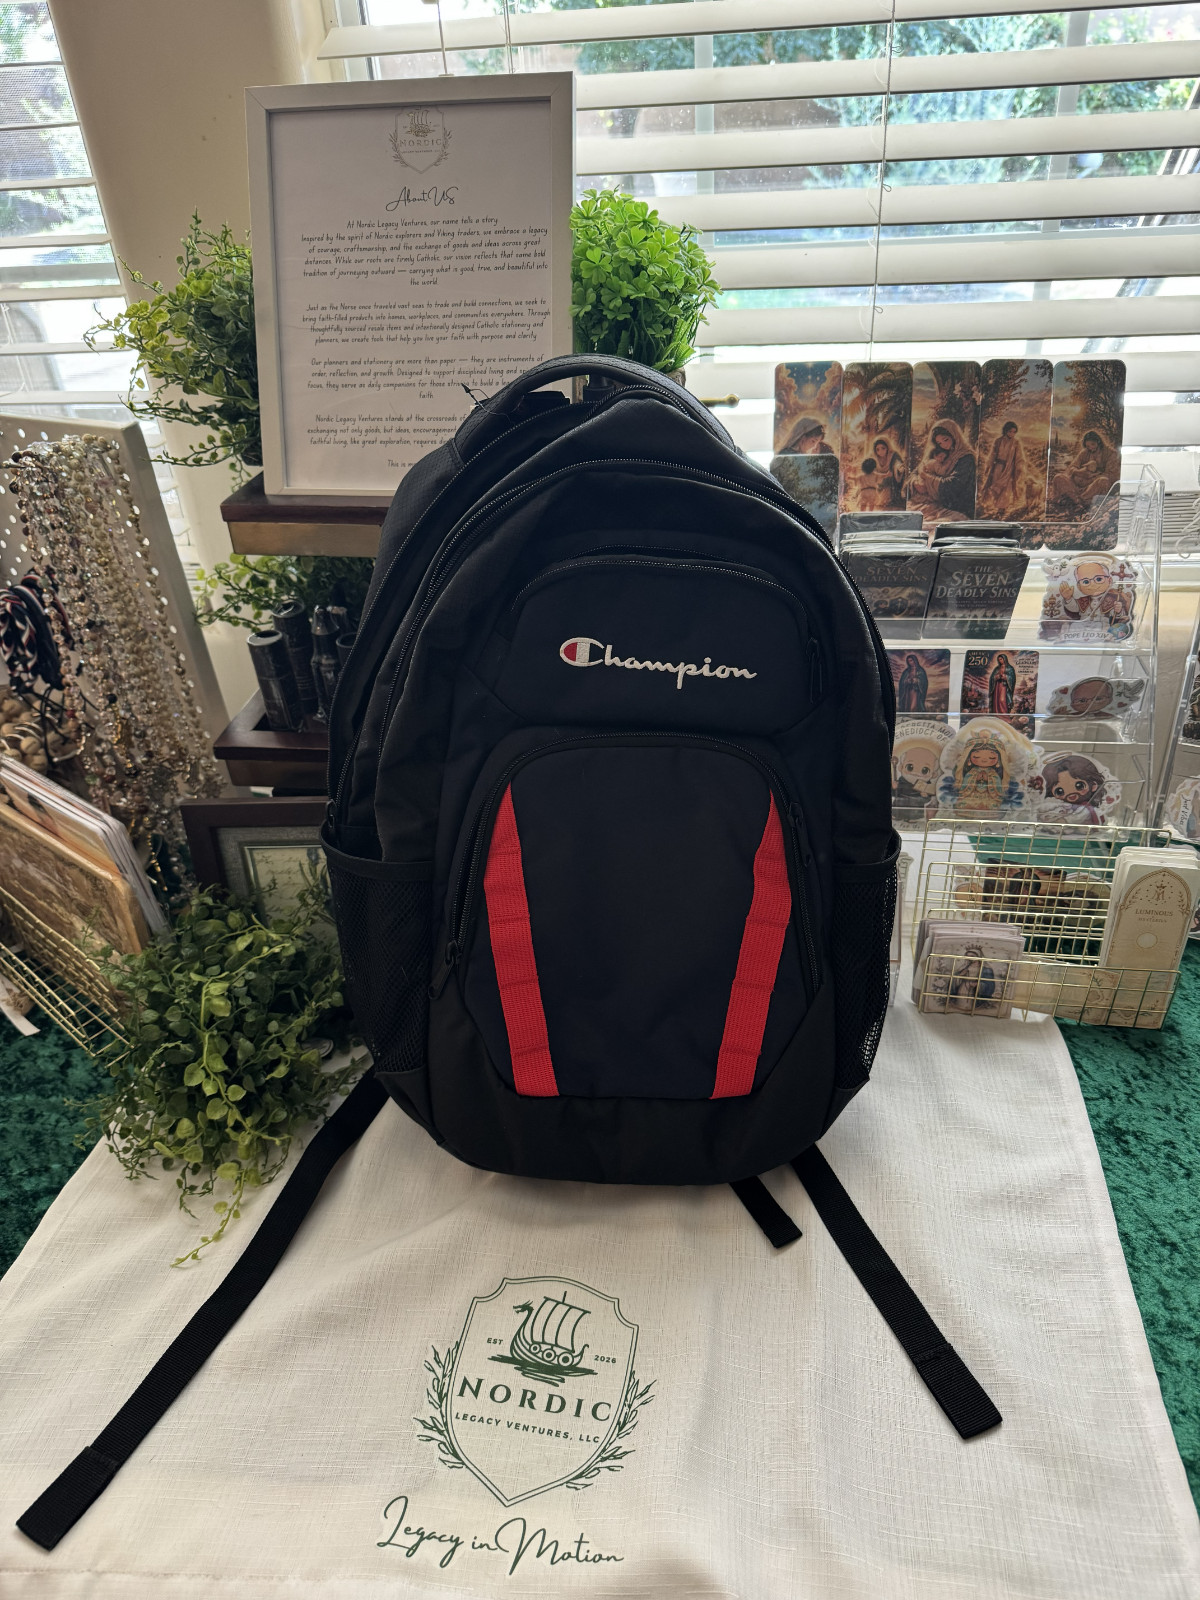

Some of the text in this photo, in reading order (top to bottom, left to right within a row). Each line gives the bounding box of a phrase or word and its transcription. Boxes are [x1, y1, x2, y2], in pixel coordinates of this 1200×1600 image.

[400, 138, 442, 147] NORDIC
[385, 186, 428, 211] About
[866, 566, 918, 576] SEVEN
[974, 565, 993, 573] THE
[855, 575, 928, 583] DEADLY SINS
[950, 571, 1009, 587] SEVEN
[935, 585, 1018, 599] DEADLY SINS
[1064, 631, 1110, 640] POPE LEO XIV
[559, 637, 758, 690] Champion
[968, 656, 988, 666] 250
[1135, 908, 1174, 917] LUMINOUS
[486, 1337, 617, 1364] EST 2026
[457, 1375, 612, 1422] NORDIC
[455, 1412, 600, 1444] LEGACY VENTURES, LLC
[377, 1495, 624, 1575] Legacy in Motion
